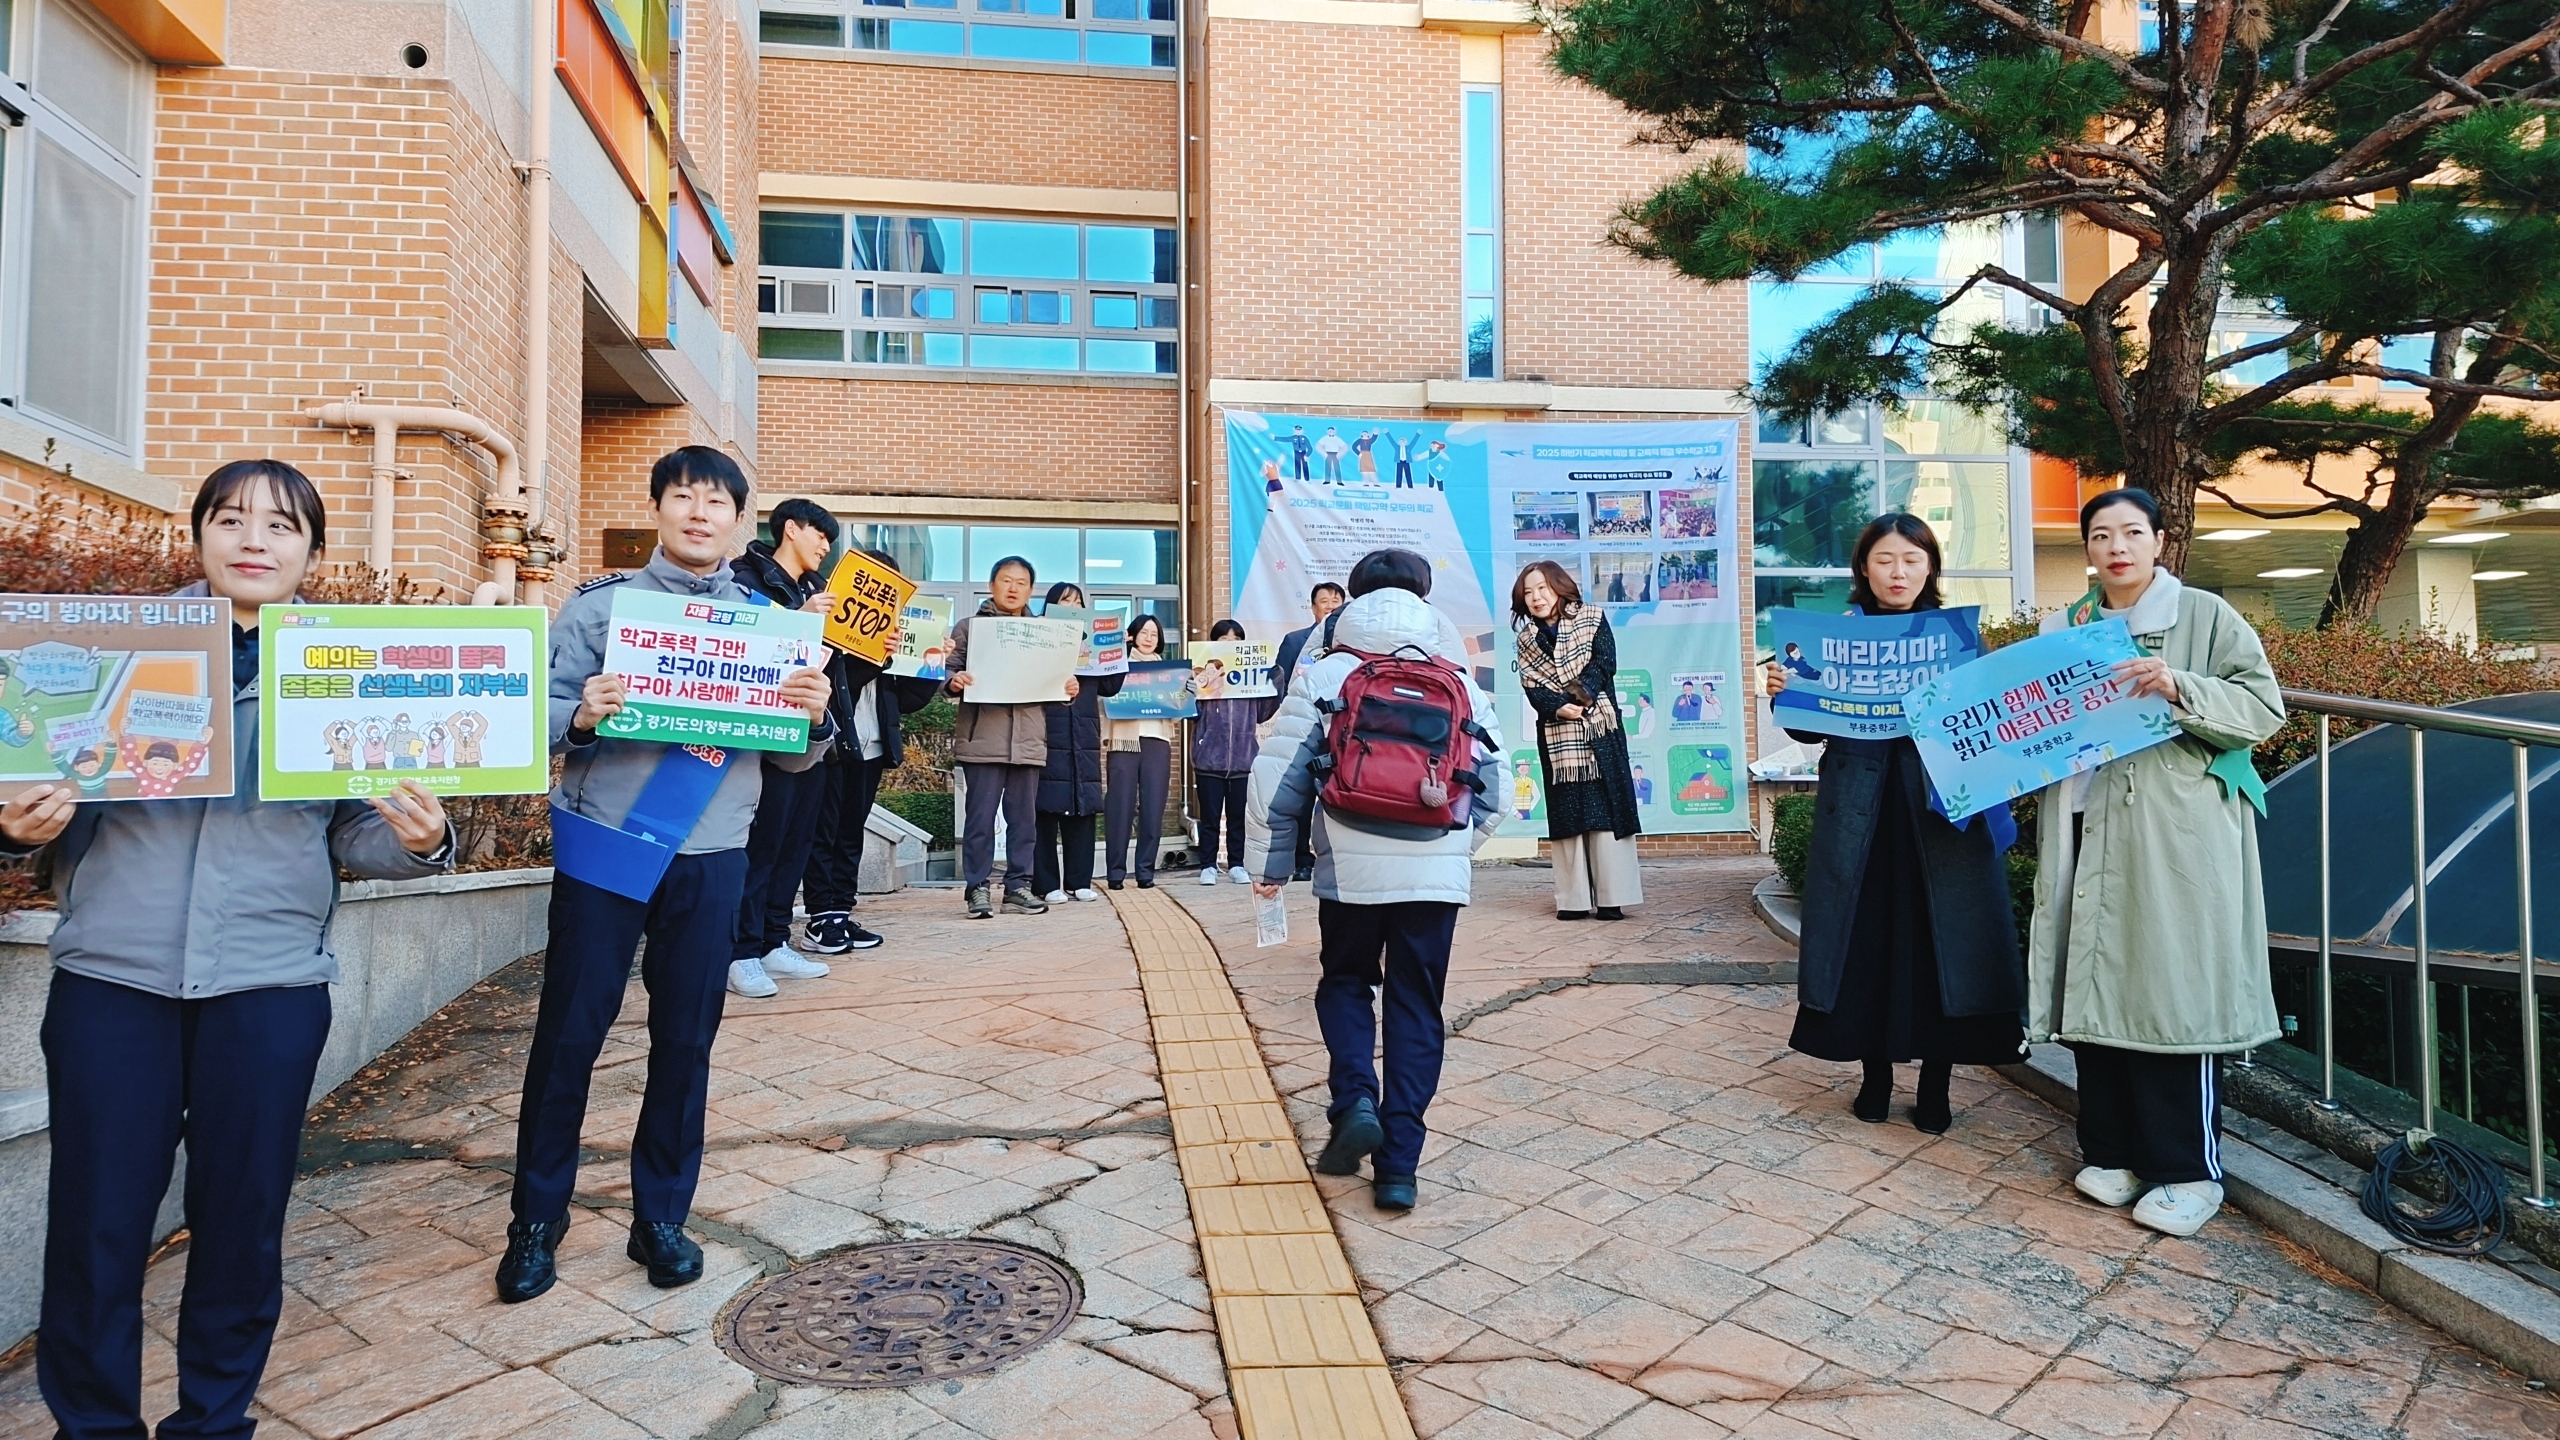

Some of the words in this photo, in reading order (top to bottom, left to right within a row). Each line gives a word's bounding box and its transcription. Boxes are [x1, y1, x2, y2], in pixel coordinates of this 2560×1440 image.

[1536, 448, 1560, 457] 2025
[1289, 498, 1317, 508] 2025
[59, 601, 132, 625] 방어자
[139, 603, 217, 626] 입니다!
[687, 604, 711, 619] 자율
[709, 610, 733, 624] 균형
[733, 612, 757, 625] 미래
[833, 596, 892, 640] STOP
[619, 627, 697, 655] 학교폭력
[702, 637, 747, 660] 그만!
[1235, 645, 1267, 655] 학교폭력
[1821, 633, 1948, 667] 때리지마!
[304, 645, 377, 670] 예의는
[381, 645, 454, 670] 학생의
[458, 645, 506, 669] 품격
[1235, 656, 1267, 666] 신고상담
[657, 655, 715, 680] 친구야
[719, 663, 782, 686] 미안해!
[1158, 674, 1171, 683] NO
[1243, 668, 1273, 686] 117
[280, 674, 354, 699] 존중은
[359, 673, 454, 698] 선생님의
[458, 673, 529, 697] 자부심
[676, 680, 740, 704] 사랑해!
[1169, 691, 1186, 700] YES
[1941, 698, 2002, 737] 우리가
[2001, 679, 2048, 714] 함께
[2045, 659, 2112, 696] 만드는
[1818, 698, 1869, 717] 학교폭력
[1871, 703, 1905, 717] 이제
[645, 714, 801, 743] 경기도의정부교육지원청
[1849, 722, 1898, 734] 부용중학교
[1951, 729, 1997, 762] 밝고
[1996, 697, 2078, 744] 아름다운
[2076, 678, 2124, 712] 공간
[2022, 731, 2075, 759] 부용중학교
[375, 775, 461, 787] 경기도부교육지원청
